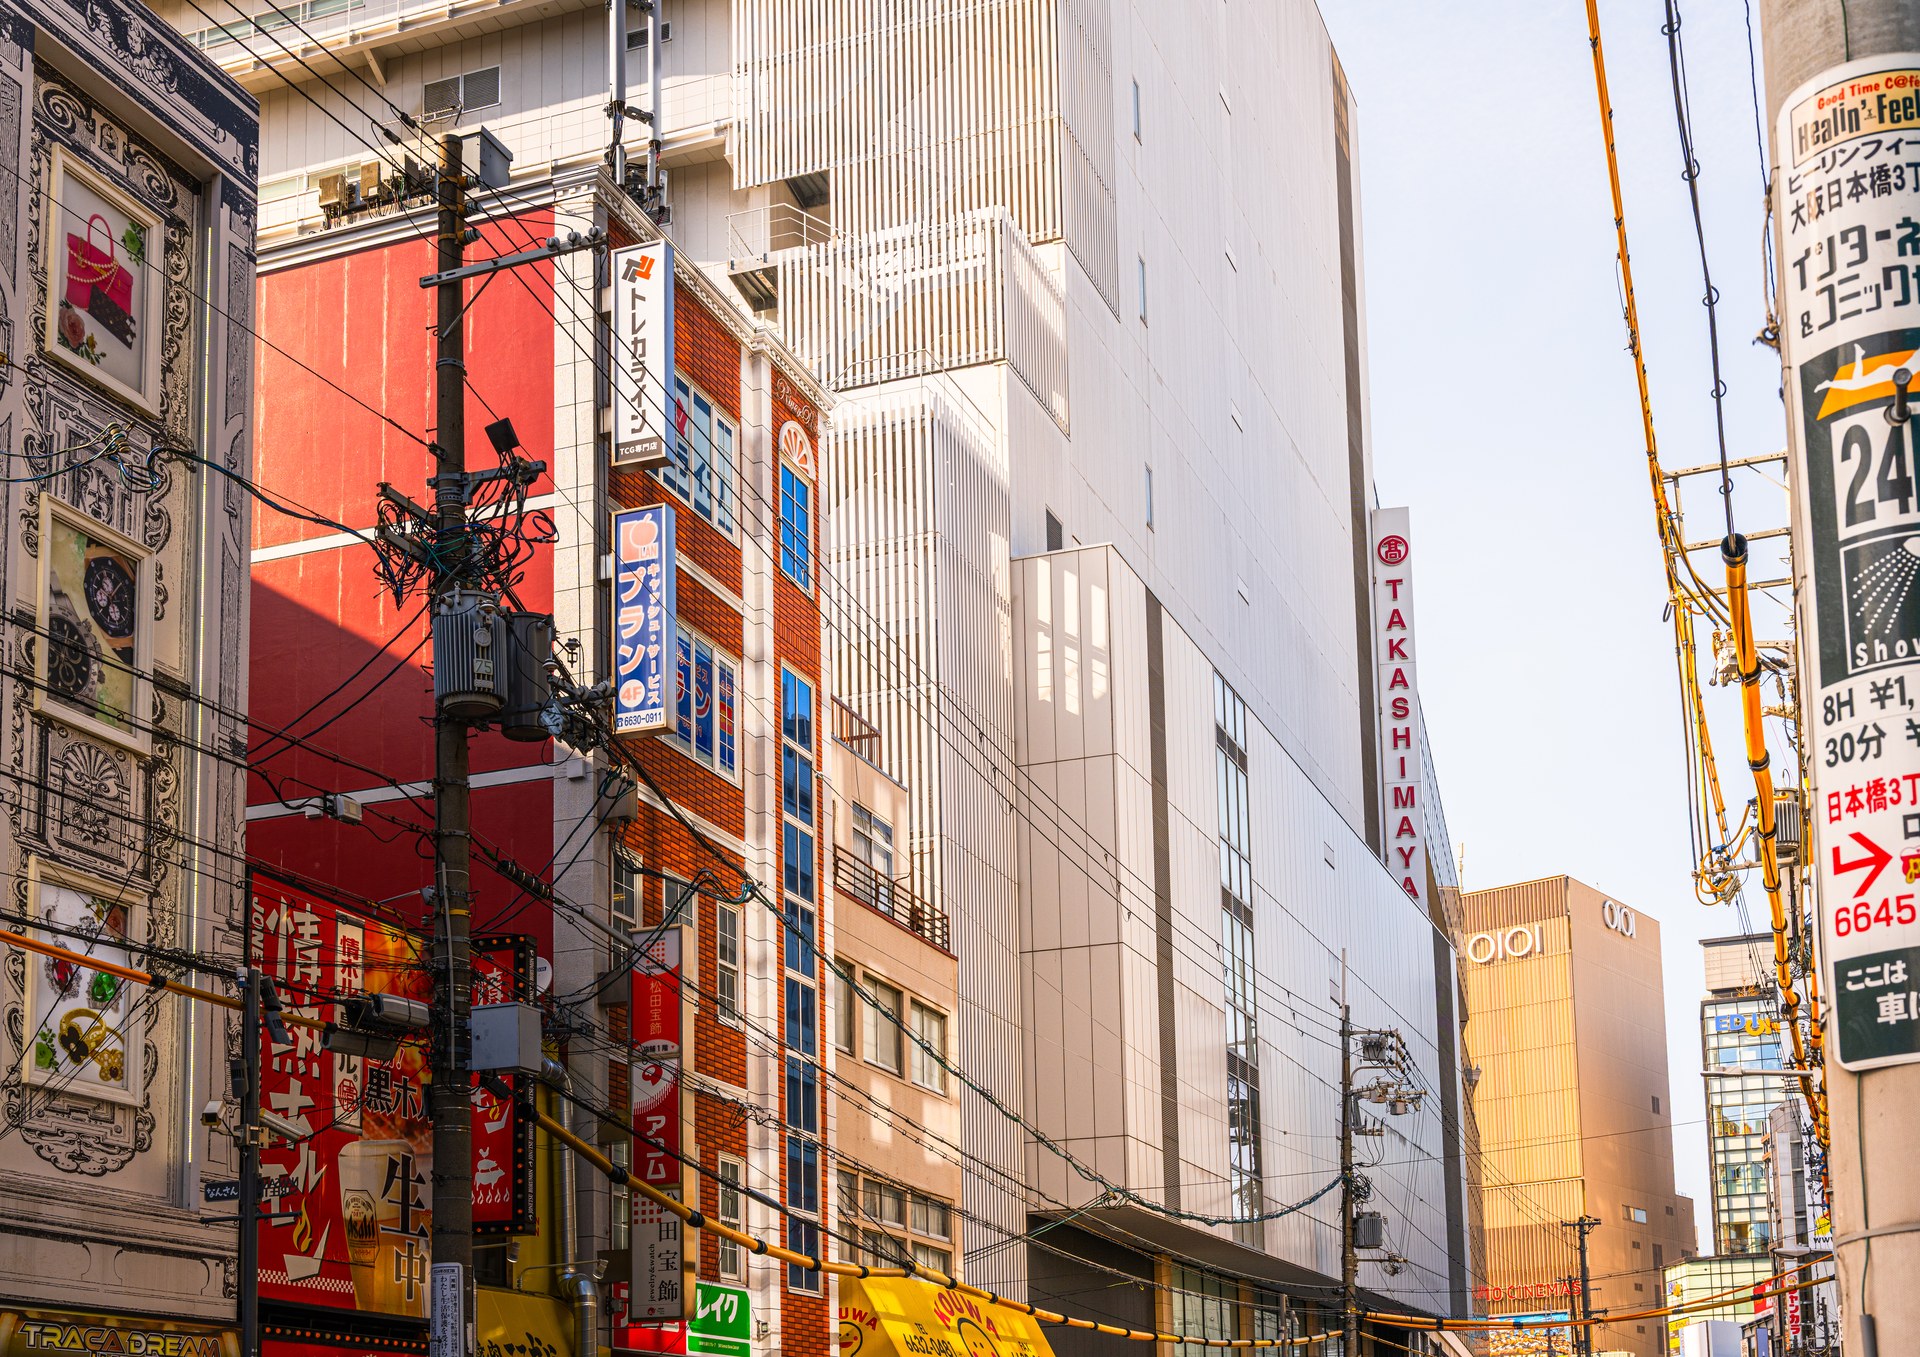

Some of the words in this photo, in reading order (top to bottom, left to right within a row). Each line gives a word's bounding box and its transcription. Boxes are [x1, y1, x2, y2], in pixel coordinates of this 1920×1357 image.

[1817, 88, 1845, 110] Good
[1850, 83, 1880, 97] Time
[630, 287, 647, 435] トレカライン
[619, 441, 658, 456] TCG専門店
[1840, 423, 1914, 528] 24
[618, 565, 646, 677] プラン
[476, 660, 493, 674] 75
[621, 687, 642, 702] 4F
[1823, 687, 1855, 726] 8H
[623, 711, 662, 728] 6630-0911
[1385, 578, 1419, 899] TAKASHIMAYA
[1825, 722, 1888, 768] 30分
[1835, 893, 1917, 938] 6645
[1845, 959, 1909, 992] ここは
[649, 980, 662, 1036] 松田宝飾
[647, 1115, 666, 1180] アコム
[206, 1186, 239, 1199] なんさん
[379, 1151, 430, 1301] 生中
[697, 1288, 739, 1324] レイク
[1507, 1281, 1582, 1300] CINEMAS
[933, 1290, 1002, 1343] KOUWA
[127, 1330, 223, 1357] DREAM
